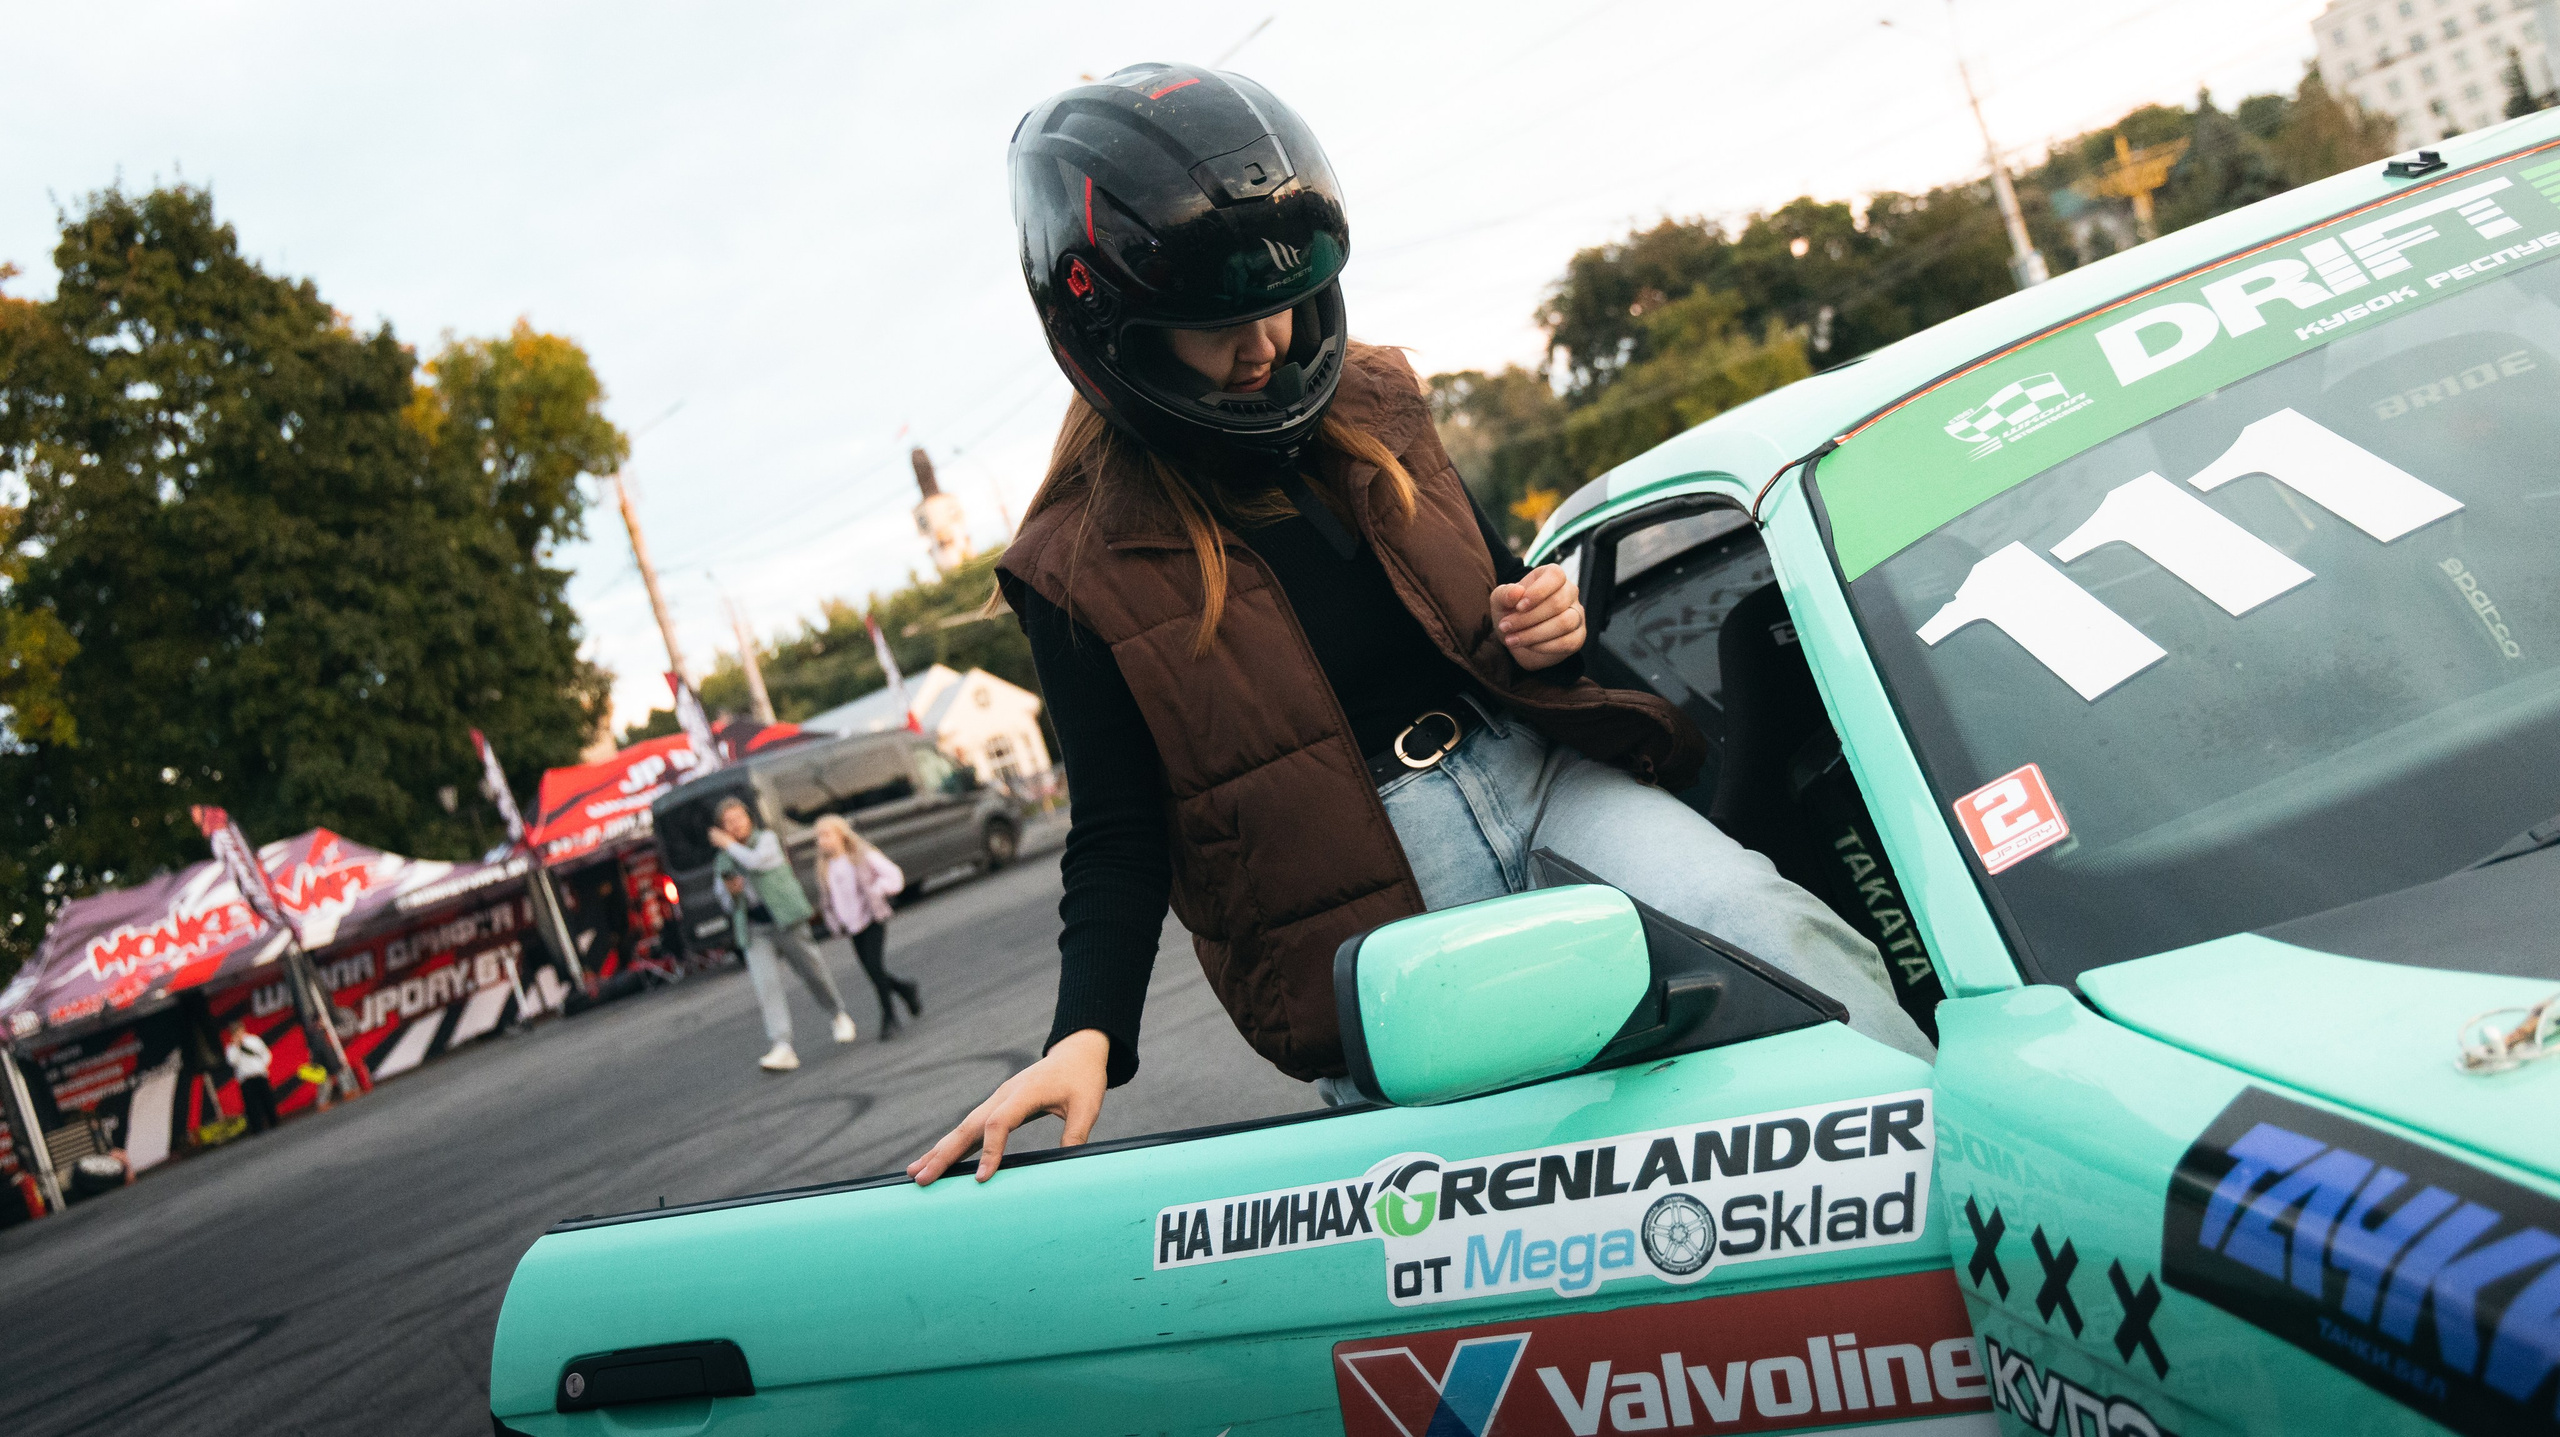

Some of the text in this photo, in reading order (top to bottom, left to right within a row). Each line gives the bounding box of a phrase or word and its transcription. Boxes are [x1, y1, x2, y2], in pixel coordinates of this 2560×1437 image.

[2095, 176, 2523, 387] DRIFT
[2294, 285, 2419, 341] КУБОК
[2002, 392, 2086, 438] ШКОЛА
[1972, 778, 2029, 847] 2
[1990, 824, 2053, 863] JP DAY
[1833, 826, 1933, 987] TAKATA
[1159, 1208, 1214, 1264] НА
[1222, 1181, 1375, 1255] ШИНАХ
[1371, 1098, 1927, 1238] GRENLANDER
[1464, 1228, 1636, 1292] Mega
[1718, 1171, 1917, 1257] Sklad
[1536, 1332, 1990, 1437] Valvoline
